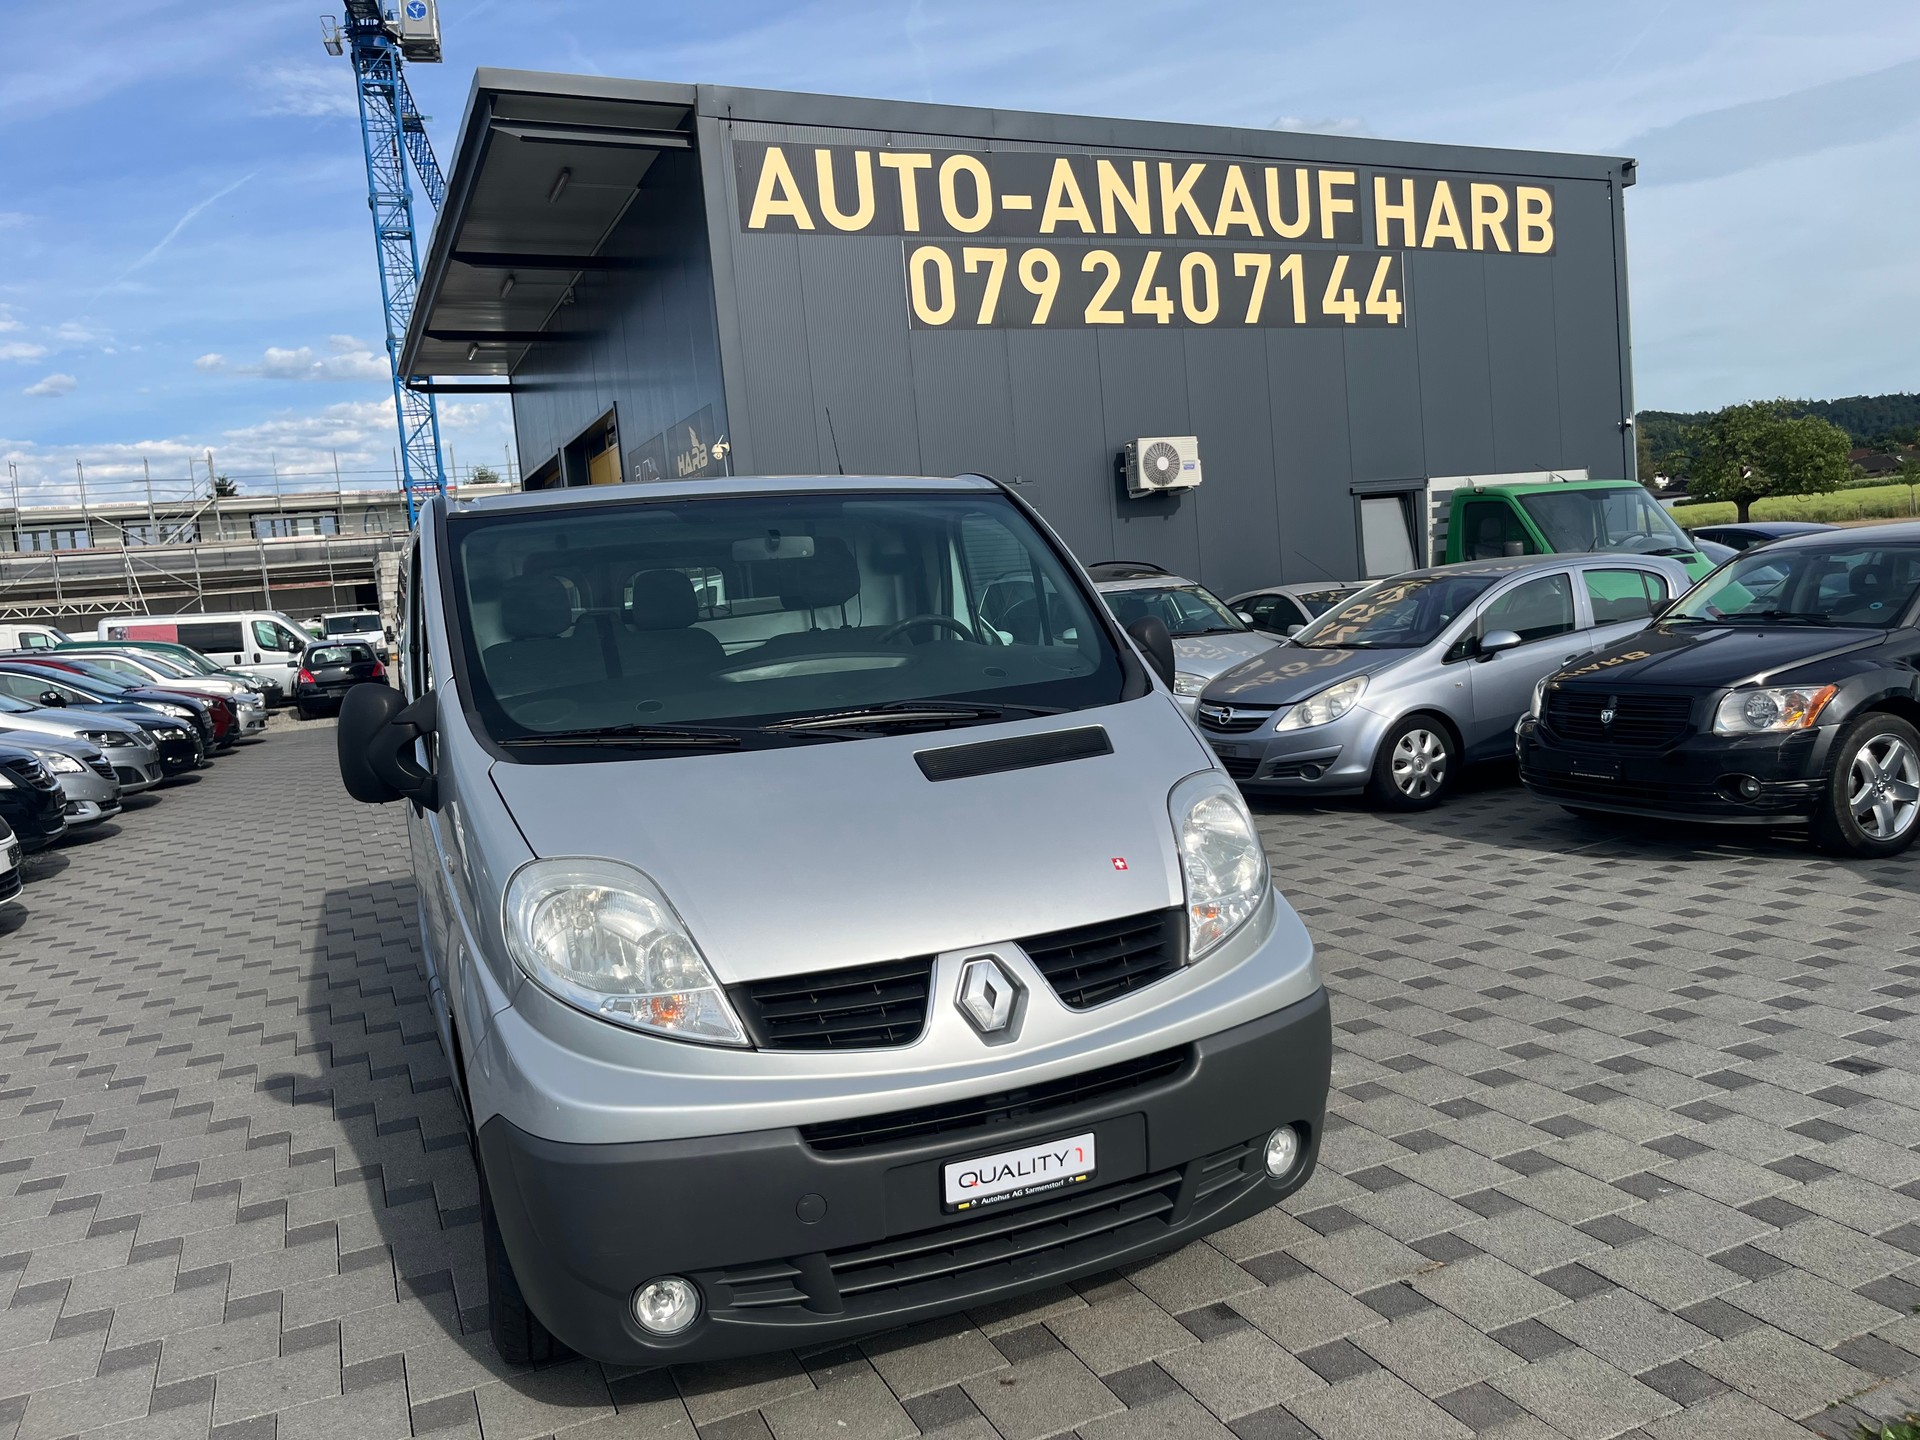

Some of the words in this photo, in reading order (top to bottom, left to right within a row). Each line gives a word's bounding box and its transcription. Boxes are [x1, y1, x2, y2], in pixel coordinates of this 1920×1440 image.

[749, 147, 1355, 239] AUTO-ANKAUF
[1374, 176, 1554, 254] HARB
[909, 245, 1061, 325] 079
[1081, 249, 1219, 324] 240
[1233, 252, 1306, 324] 71
[1322, 255, 1402, 324] 44
[677, 443, 708, 477] HARB
[958, 1149, 1069, 1188] QUALITY
[1075, 1147, 1083, 1163] 1
[981, 1193, 1010, 1205] Autohus
[1012, 1189, 1023, 1198] AG
[1025, 1179, 1064, 1195] Sarmenstorf
